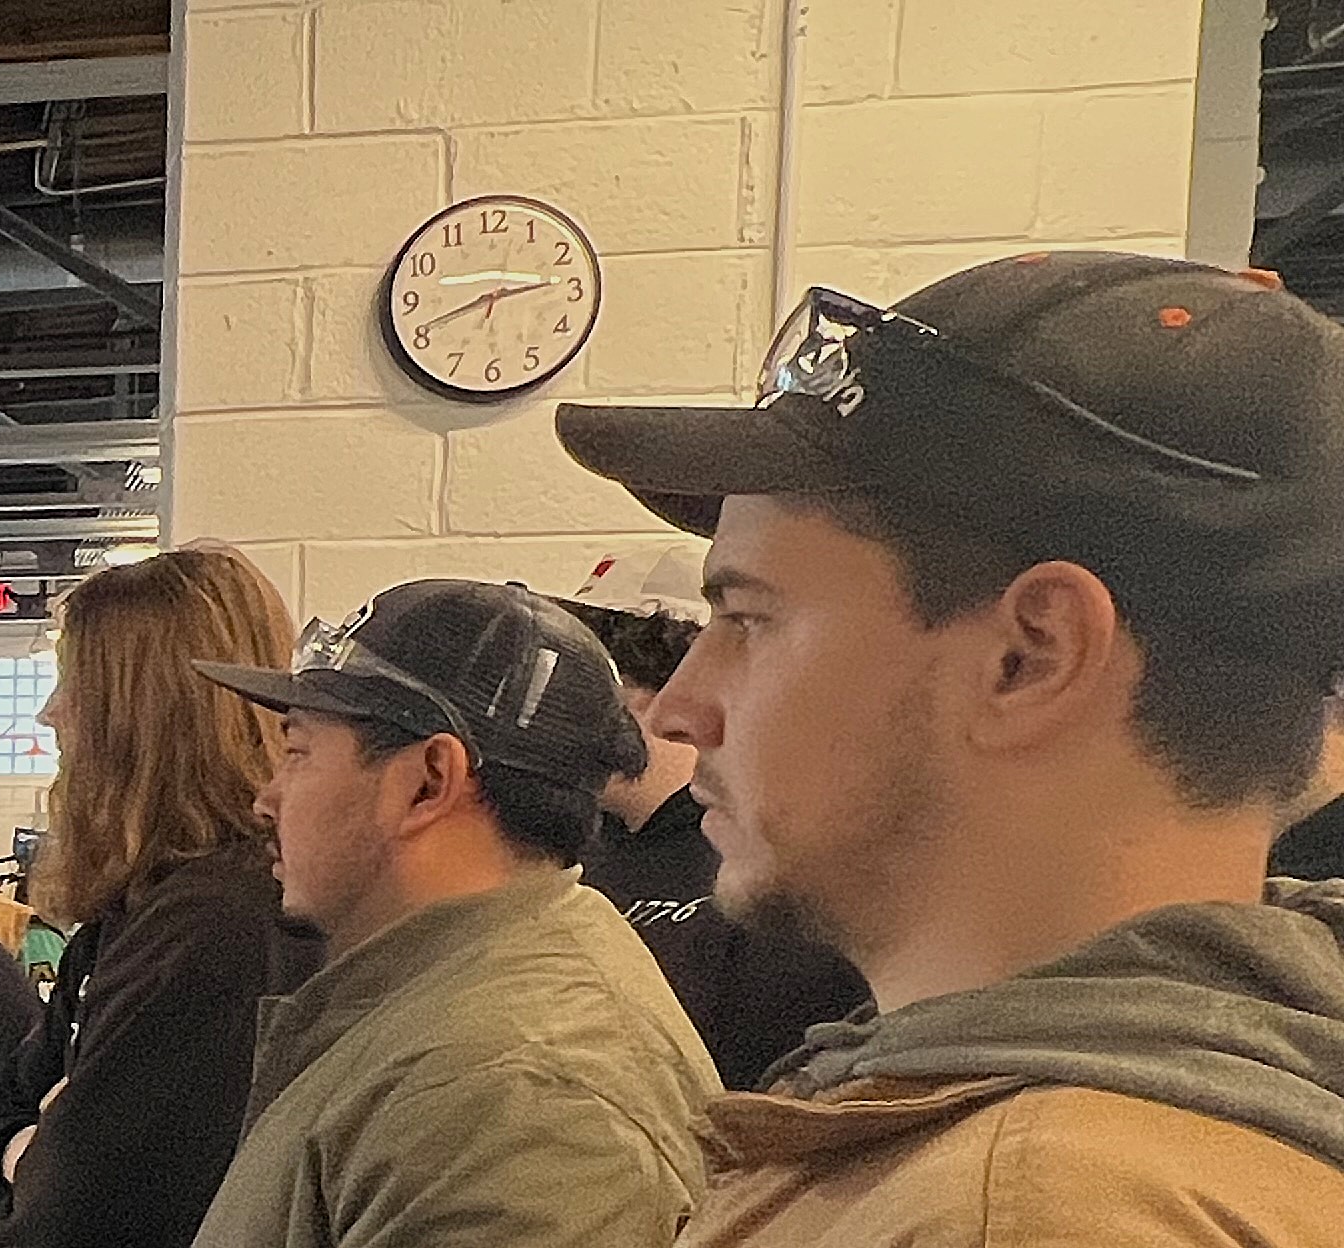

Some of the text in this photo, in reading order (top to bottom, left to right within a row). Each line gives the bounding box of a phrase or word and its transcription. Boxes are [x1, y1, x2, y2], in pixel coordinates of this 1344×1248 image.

[479, 210, 509, 235] 12
[526, 219, 536, 243] 1
[442, 223, 463, 248] 11
[410, 252, 436, 277] 10
[553, 242, 572, 266] 2
[567, 278, 584, 302] 3
[402, 291, 419, 316] 9
[552, 314, 571, 334] 4
[413, 325, 431, 350] 8
[447, 352, 464, 377] 7
[484, 358, 502, 383] 6
[523, 347, 540, 371] 5
[624, 894, 712, 927] 1776
